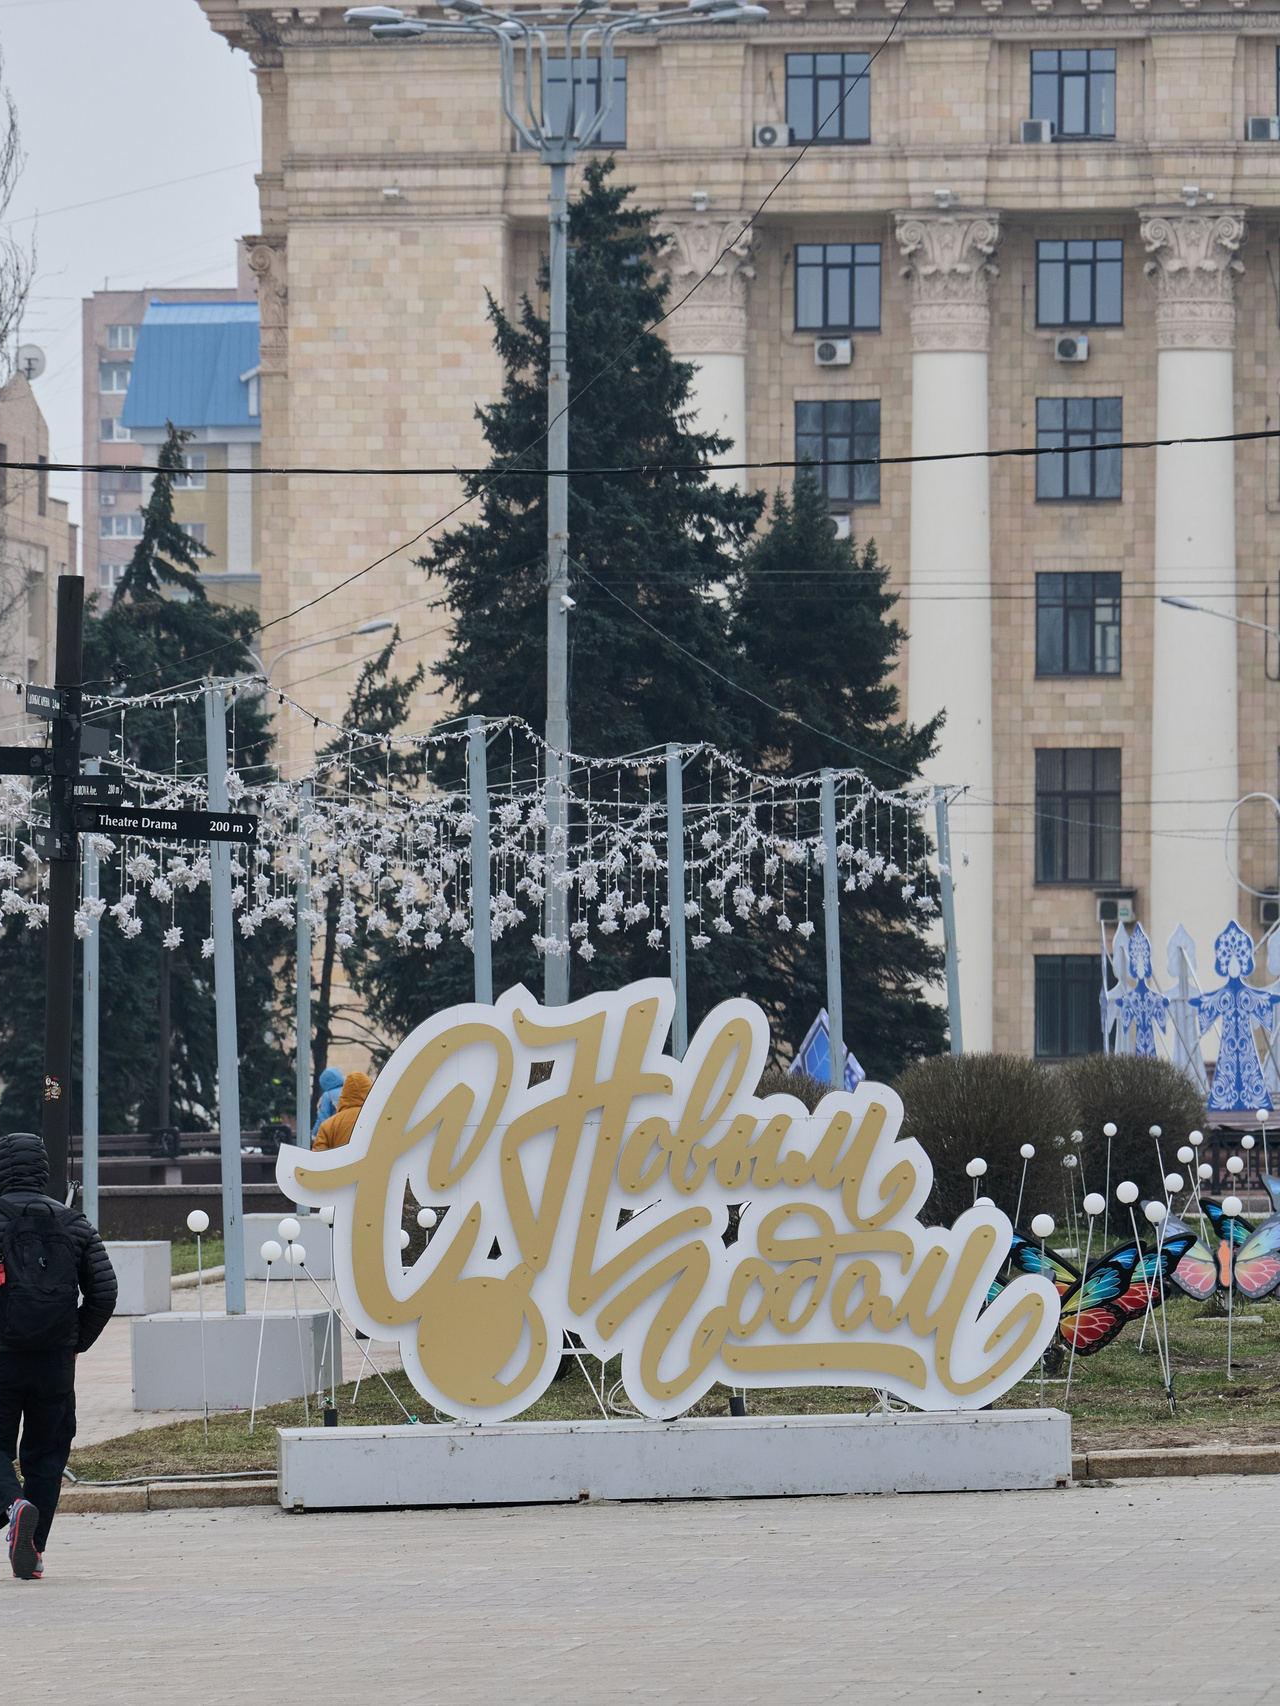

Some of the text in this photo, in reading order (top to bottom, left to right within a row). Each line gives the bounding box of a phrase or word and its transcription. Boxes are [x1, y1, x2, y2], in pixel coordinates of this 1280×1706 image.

[98, 814, 244, 833] Theatre Drama 200 m
[294, 998, 917, 1326] С Новым
